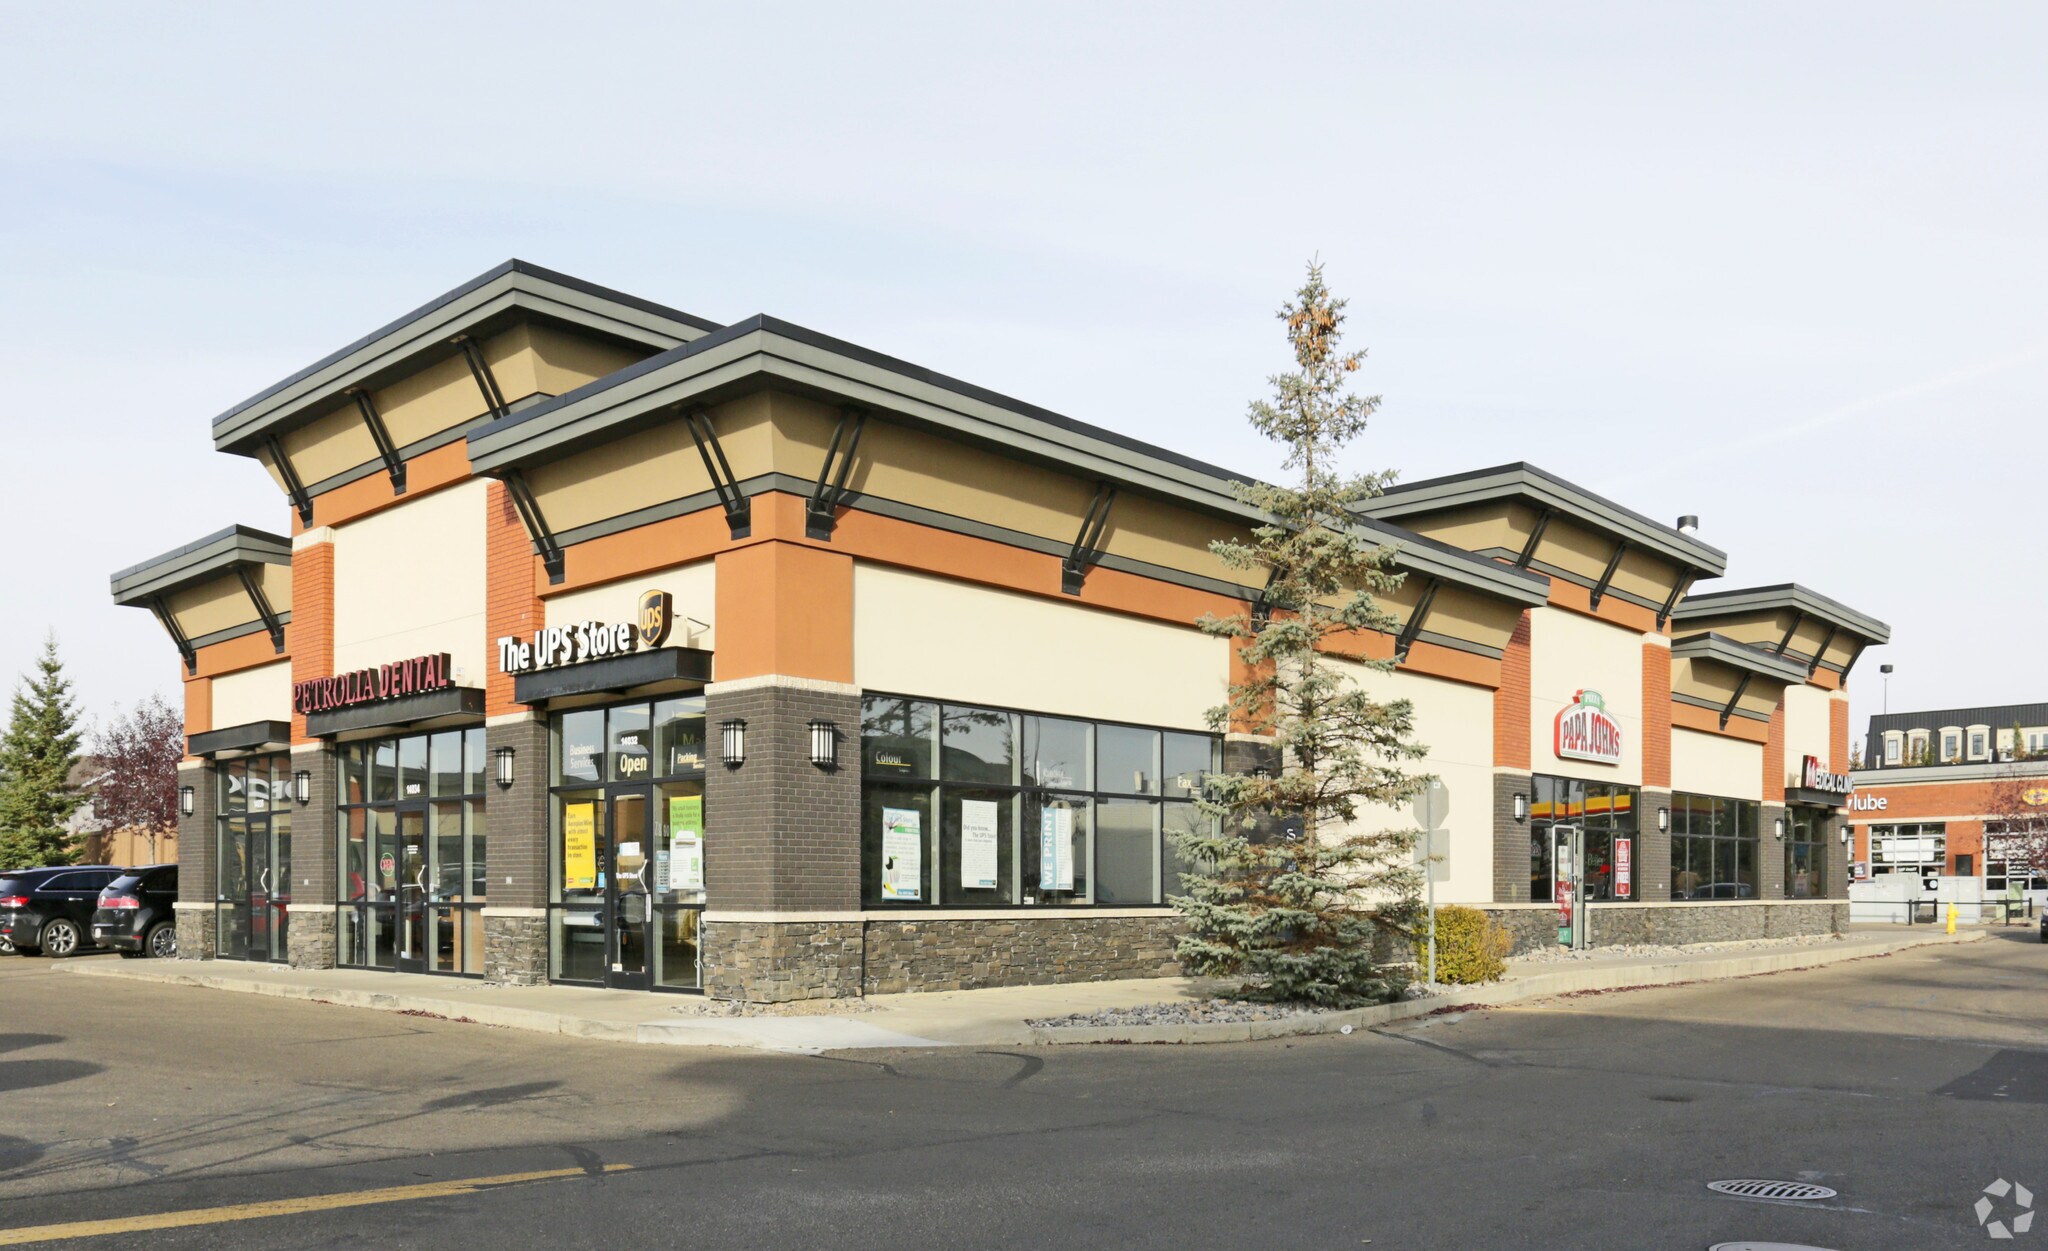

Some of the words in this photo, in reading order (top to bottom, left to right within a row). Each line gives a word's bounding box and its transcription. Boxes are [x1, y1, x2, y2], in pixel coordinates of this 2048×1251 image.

[641, 605, 661, 637] ups
[497, 636, 530, 672] The
[534, 624, 573, 666] UPS
[577, 620, 630, 658] Store
[292, 668, 375, 712] PETROLIA
[379, 652, 449, 697] DENTAL
[1562, 712, 1587, 751] PAPA
[569, 744, 595, 756] Business
[620, 754, 647, 777] Open
[875, 751, 901, 763] Colour
[1177, 776, 1192, 788] Fax
[1805, 757, 1836, 792] MEDICAL
[1837, 774, 1855, 794] CLINIC
[1044, 812, 1053, 857] PRINT
[1044, 861, 1054, 885] WE
